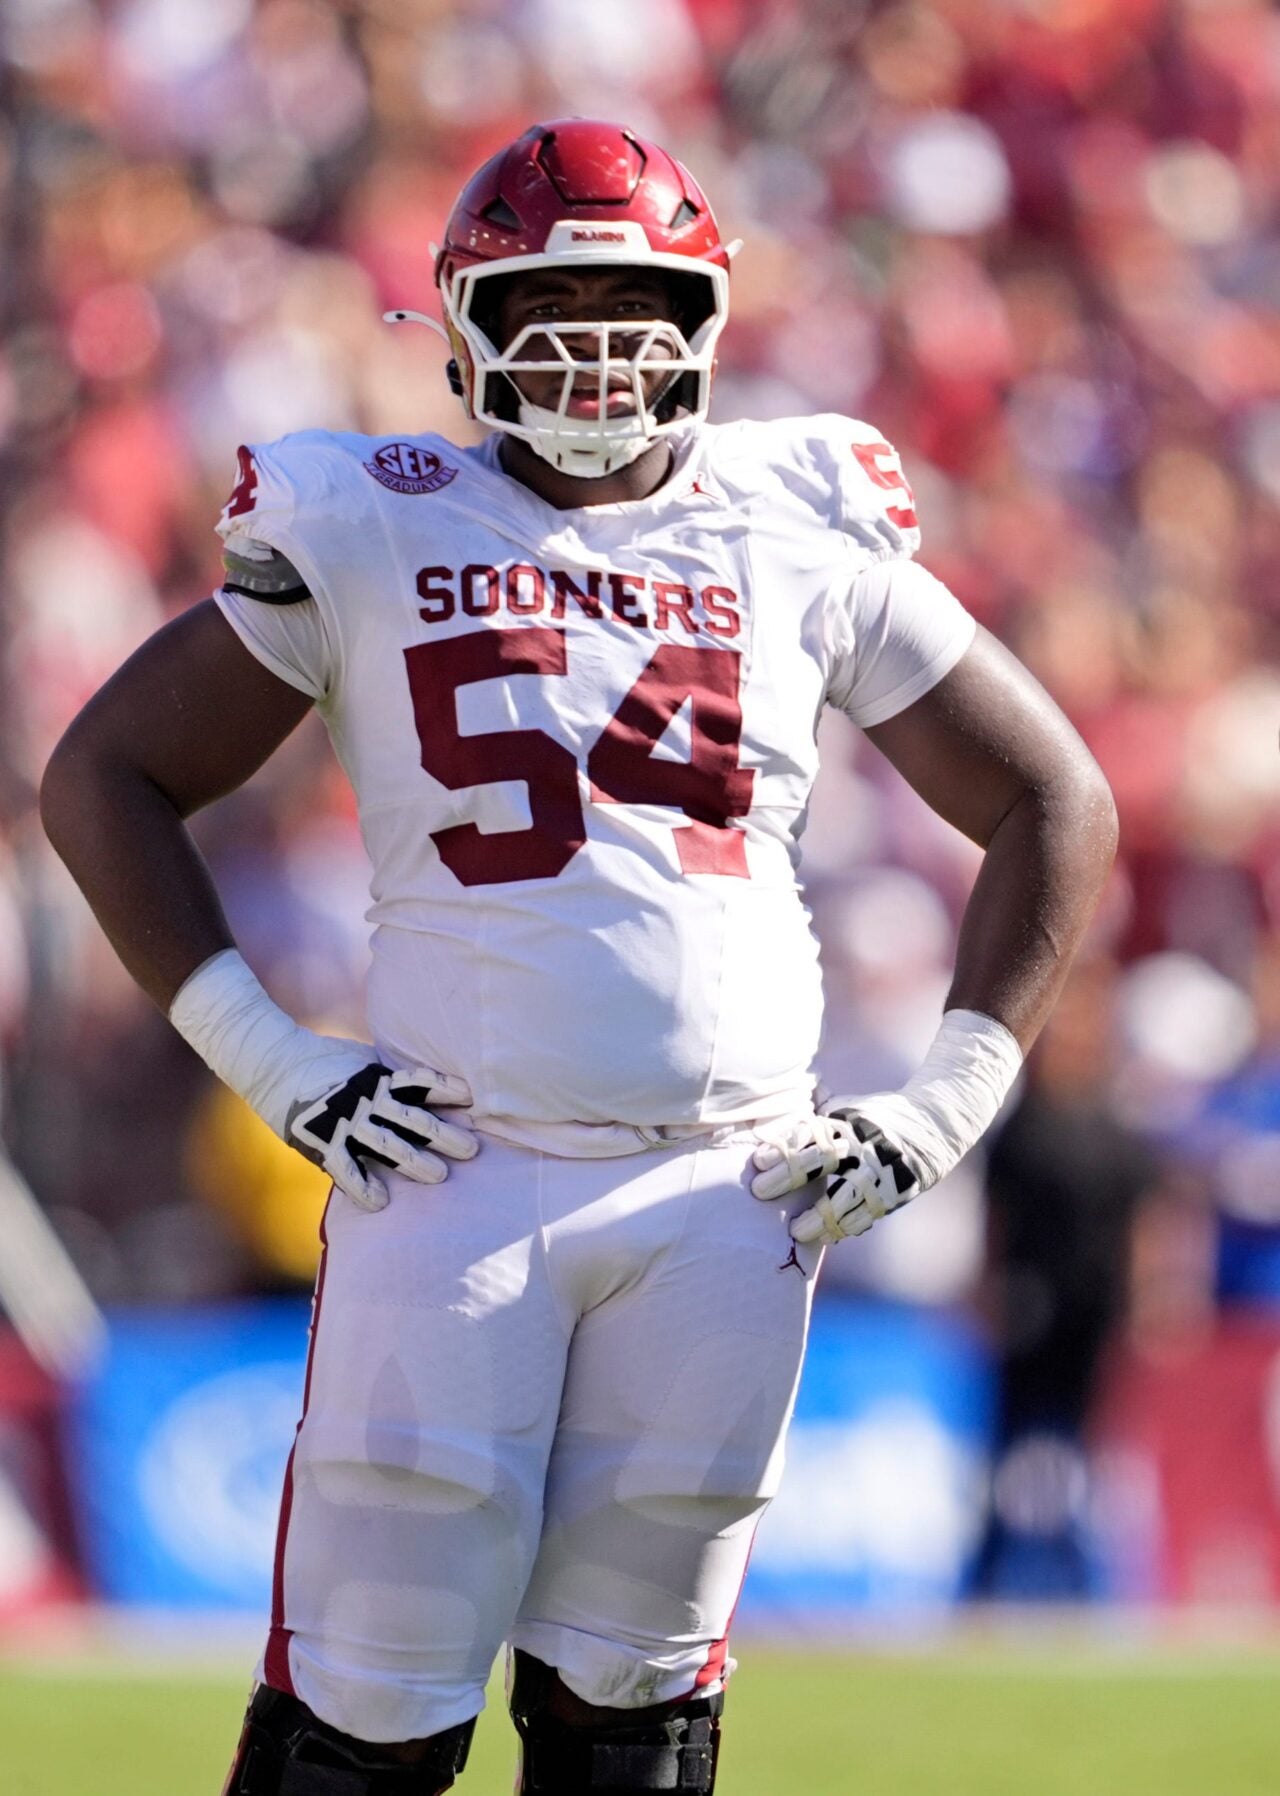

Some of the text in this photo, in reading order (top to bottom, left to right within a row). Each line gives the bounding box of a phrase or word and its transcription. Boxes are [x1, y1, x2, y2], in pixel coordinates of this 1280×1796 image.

[376, 472, 442, 492] GRADUATE
[377, 445, 437, 479] SEC
[416, 563, 742, 638] SOONERS
[403, 628, 756, 887] 54
